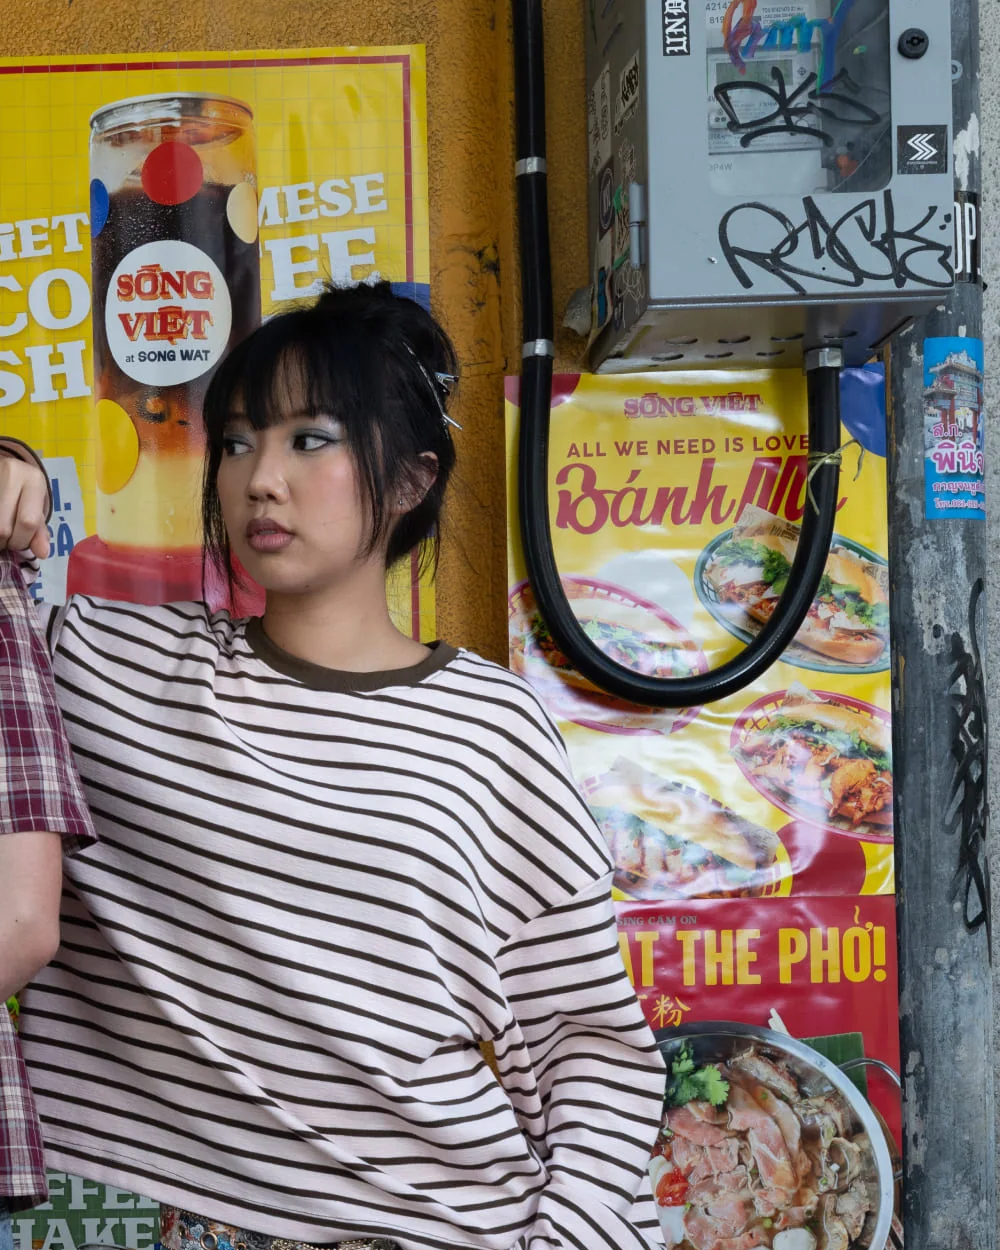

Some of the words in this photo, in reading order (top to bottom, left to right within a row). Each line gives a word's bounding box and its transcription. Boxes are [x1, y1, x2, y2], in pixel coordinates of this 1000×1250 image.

[125, 353, 135, 363] at
[137, 350, 177, 363] SONG
[179, 349, 211, 362] WAT
[567, 443, 607, 459] ALL
[614, 440, 649, 457] WE
[657, 437, 716, 455] NEED
[725, 436, 745, 452] IS
[753, 434, 809, 452] LOVE
[556, 457, 737, 535] Bánh
[676, 928, 762, 987] THE
